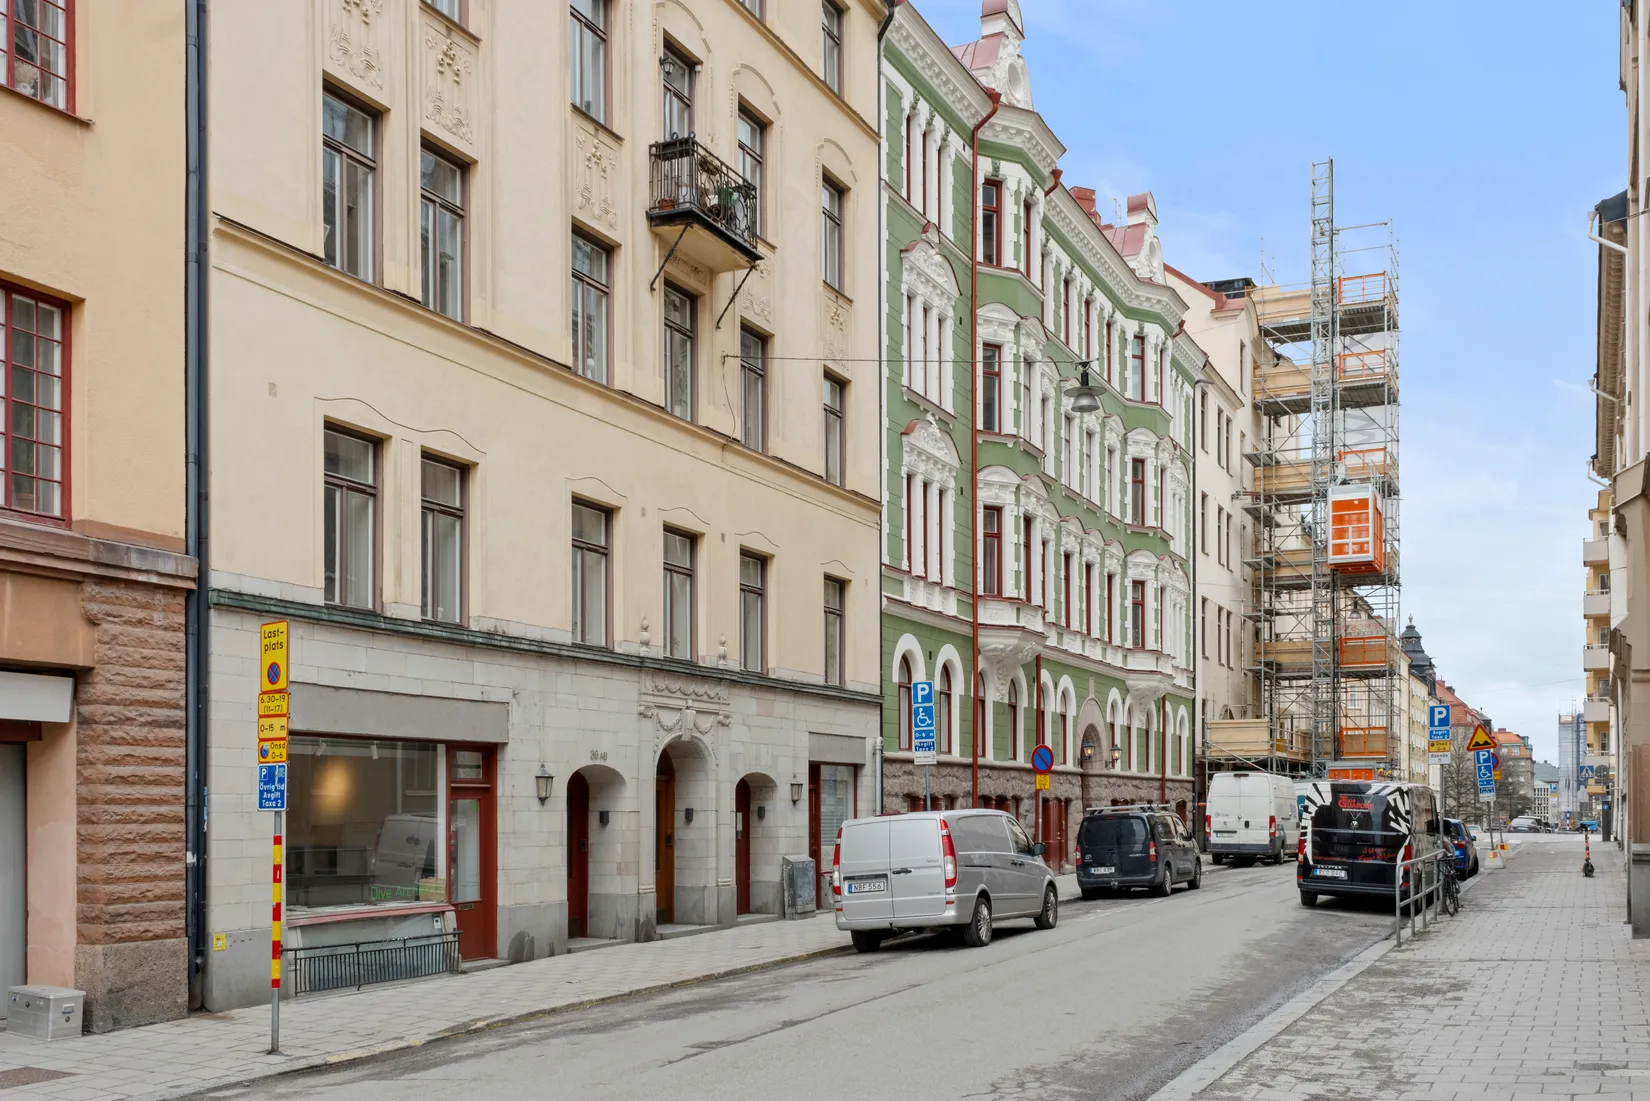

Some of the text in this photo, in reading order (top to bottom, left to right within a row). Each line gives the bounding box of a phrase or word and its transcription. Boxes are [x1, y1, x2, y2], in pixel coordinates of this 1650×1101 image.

[263, 628, 284, 640] Last-
[264, 640, 284, 654] plats
[917, 684, 929, 702] P
[260, 694, 286, 704] 6.30-19
[1434, 707, 1447, 726] P
[260, 723, 274, 732] 0-15
[270, 742, 286, 750] Onsd
[271, 751, 284, 759] 0-6
[1479, 751, 1489, 764] P
[261, 768, 267, 779] P
[260, 781, 275, 792] Övrig
[263, 791, 281, 800] Avgift
[262, 799, 282, 807] Taxa 2
